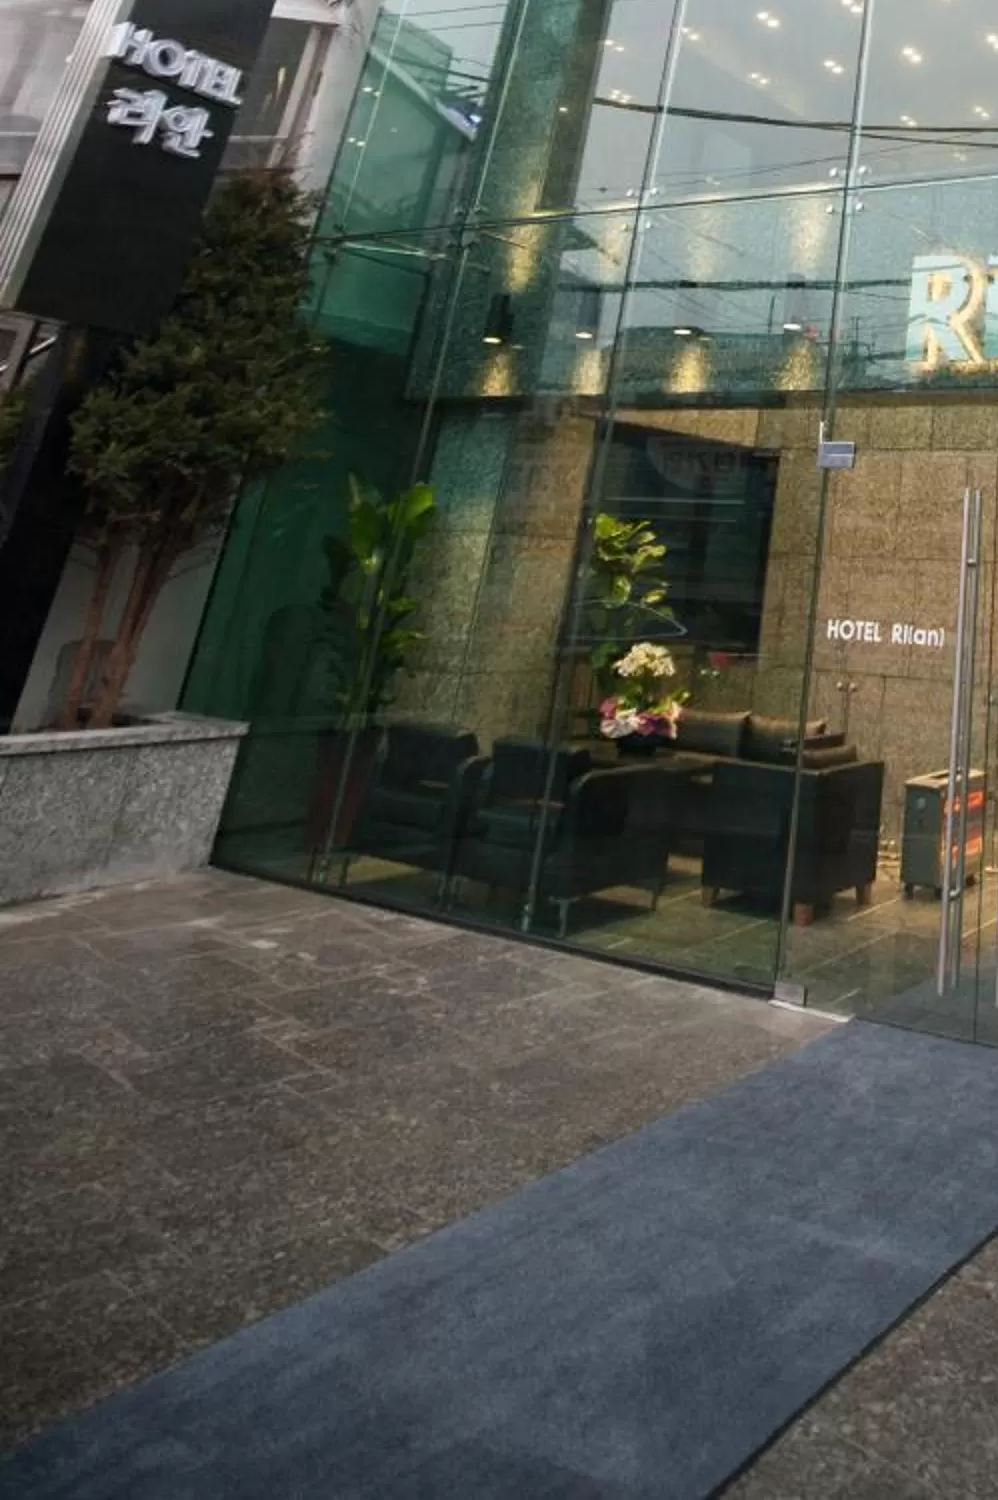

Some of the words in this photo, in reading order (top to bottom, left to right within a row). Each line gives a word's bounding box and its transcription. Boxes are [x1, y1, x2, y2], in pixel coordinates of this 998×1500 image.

[106, 21, 243, 106] HOTEL
[105, 87, 214, 158] 리안
[827, 618, 882, 643] HOTEL
